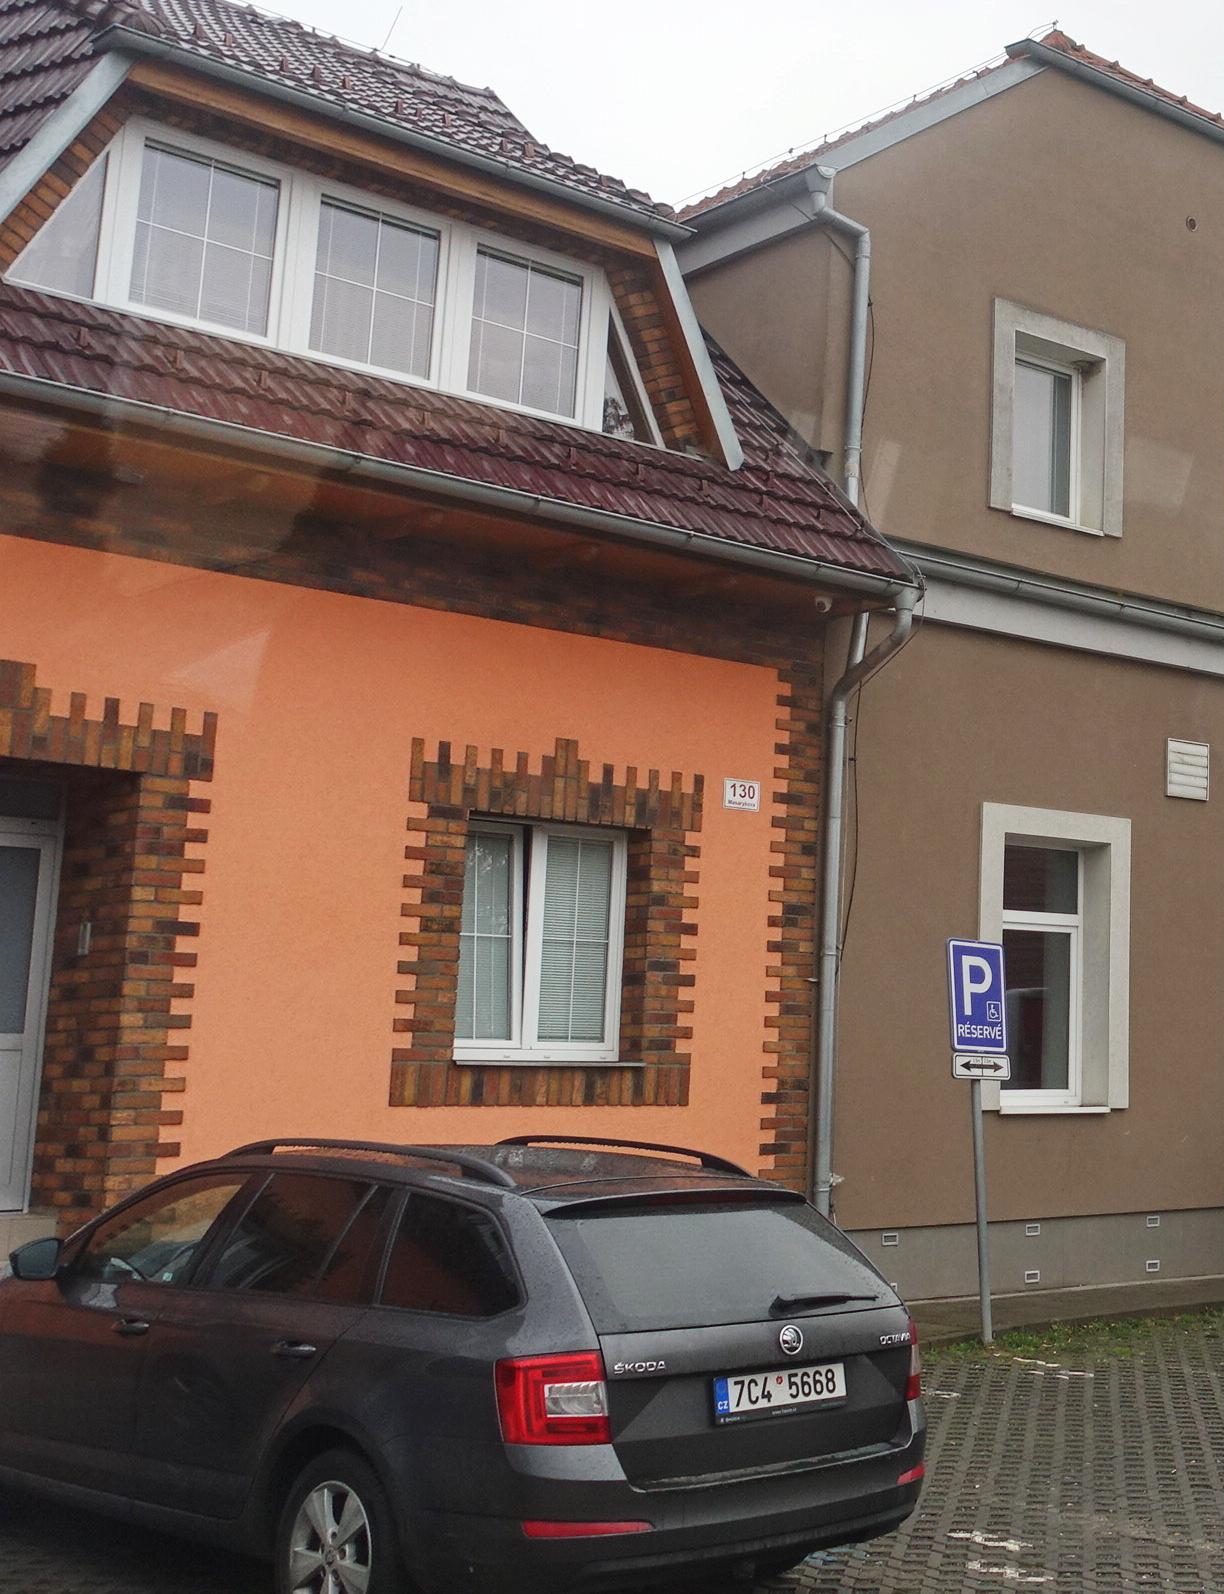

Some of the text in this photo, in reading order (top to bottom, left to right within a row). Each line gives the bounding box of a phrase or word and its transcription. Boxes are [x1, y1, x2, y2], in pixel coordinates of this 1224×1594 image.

[730, 783, 756, 799] 130
[962, 955, 993, 1016] P
[958, 1021, 1003, 1040] RÉSERVÉ
[879, 1331, 911, 1345] OCTAVIA
[613, 1360, 666, 1375] ŠKODA
[733, 1368, 837, 1408] 7C4 5668
[717, 1400, 729, 1411] CZ
